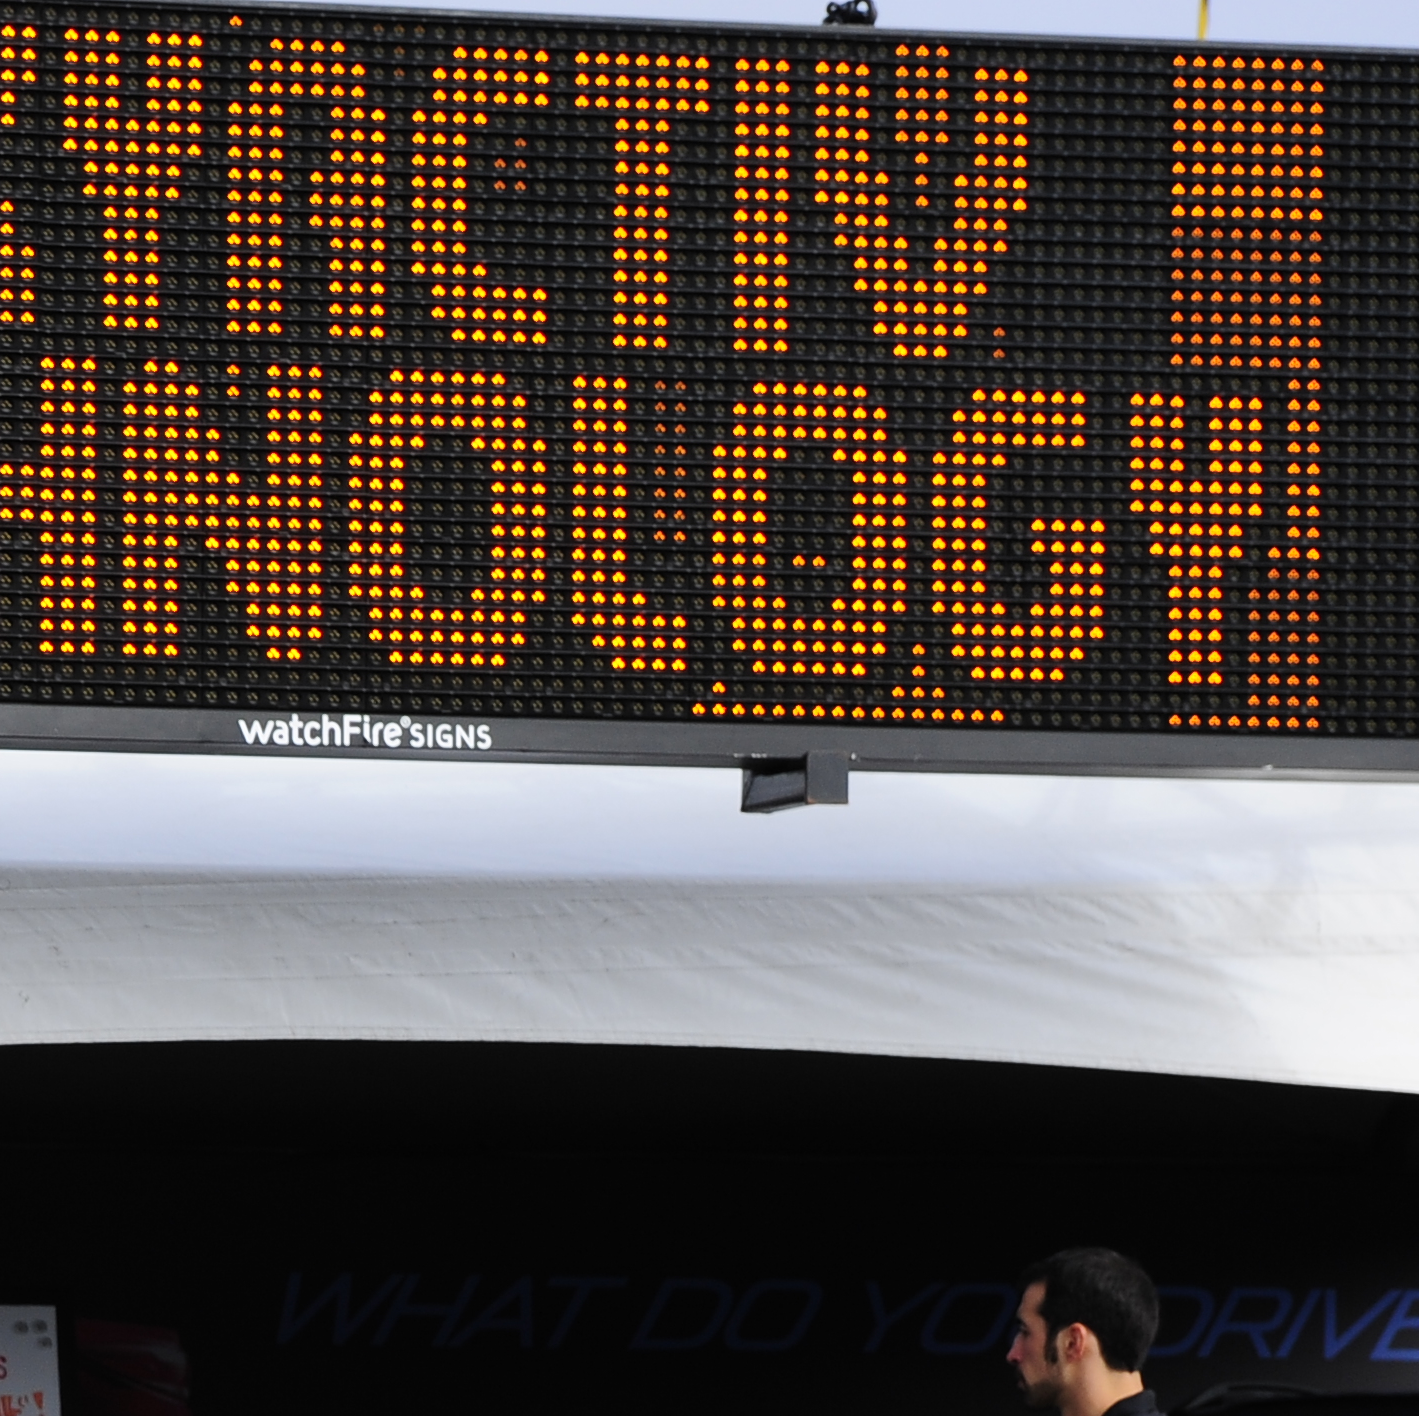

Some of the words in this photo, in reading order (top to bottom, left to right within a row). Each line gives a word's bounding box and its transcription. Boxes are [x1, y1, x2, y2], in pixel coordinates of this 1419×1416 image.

[410, 723, 492, 750] SIGNS
[275, 1270, 629, 1349] WHAT
[628, 1277, 825, 1353] DO
[862, 1279, 1019, 1356] YO
